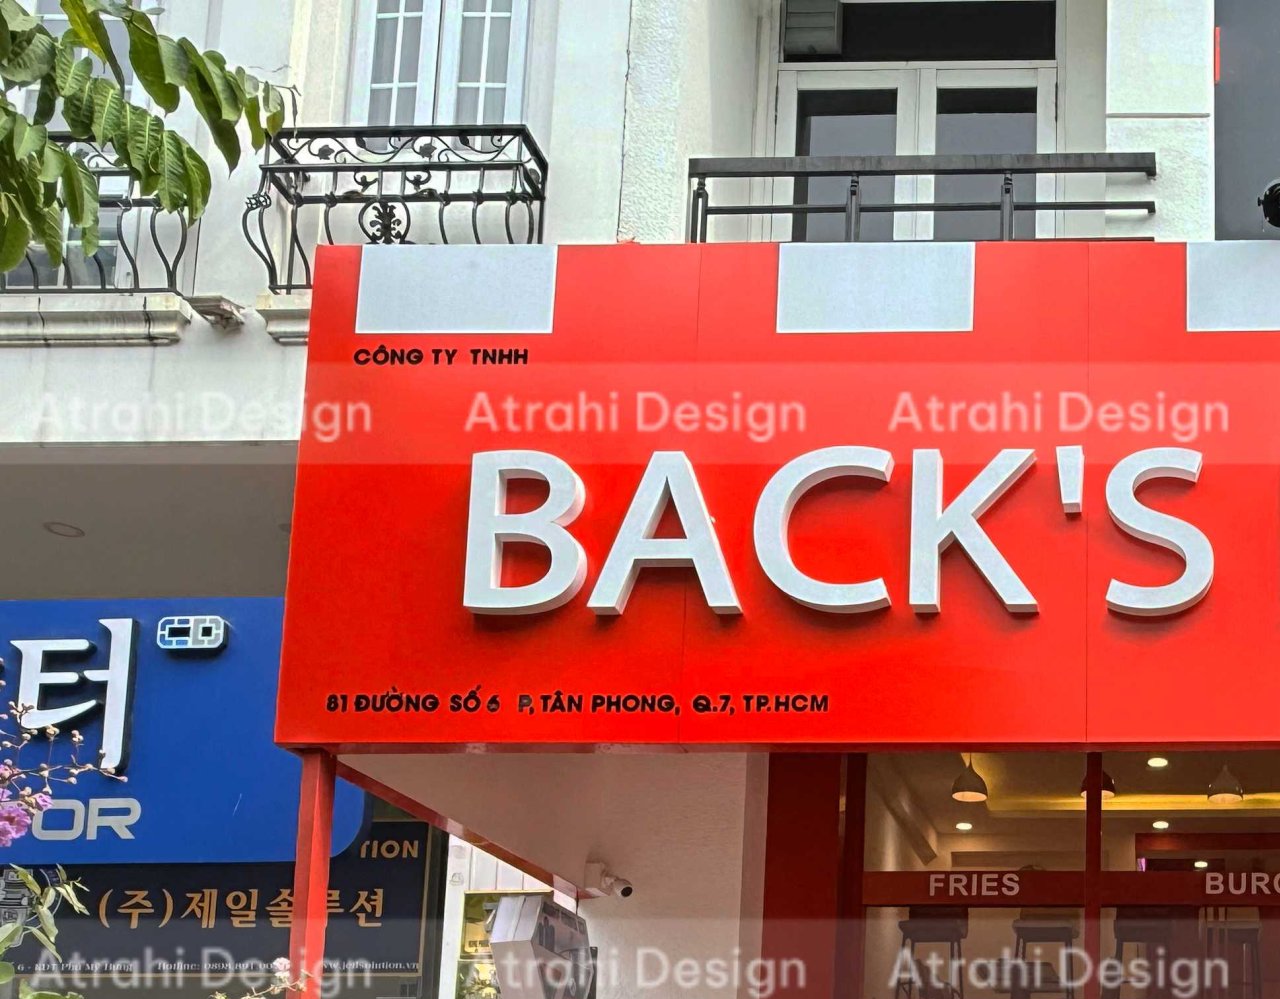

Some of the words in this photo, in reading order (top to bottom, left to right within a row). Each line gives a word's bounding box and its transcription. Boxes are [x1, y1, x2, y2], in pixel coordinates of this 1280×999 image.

[353, 344, 424, 366] CÔNG
[431, 348, 458, 365] TY
[469, 348, 529, 365] TNHH
[461, 443, 1217, 621] BACK'S
[326, 694, 347, 712] 81
[354, 685, 439, 713] ĐƯỜNG
[449, 683, 482, 713] SỐ
[486, 694, 500, 713] 6
[541, 689, 583, 713] TÂN
[591, 694, 681, 715] PHONG,
[692, 694, 735, 715] Q.7,
[742, 694, 829, 713] TP.HCM
[928, 873, 1021, 897] FRIES
